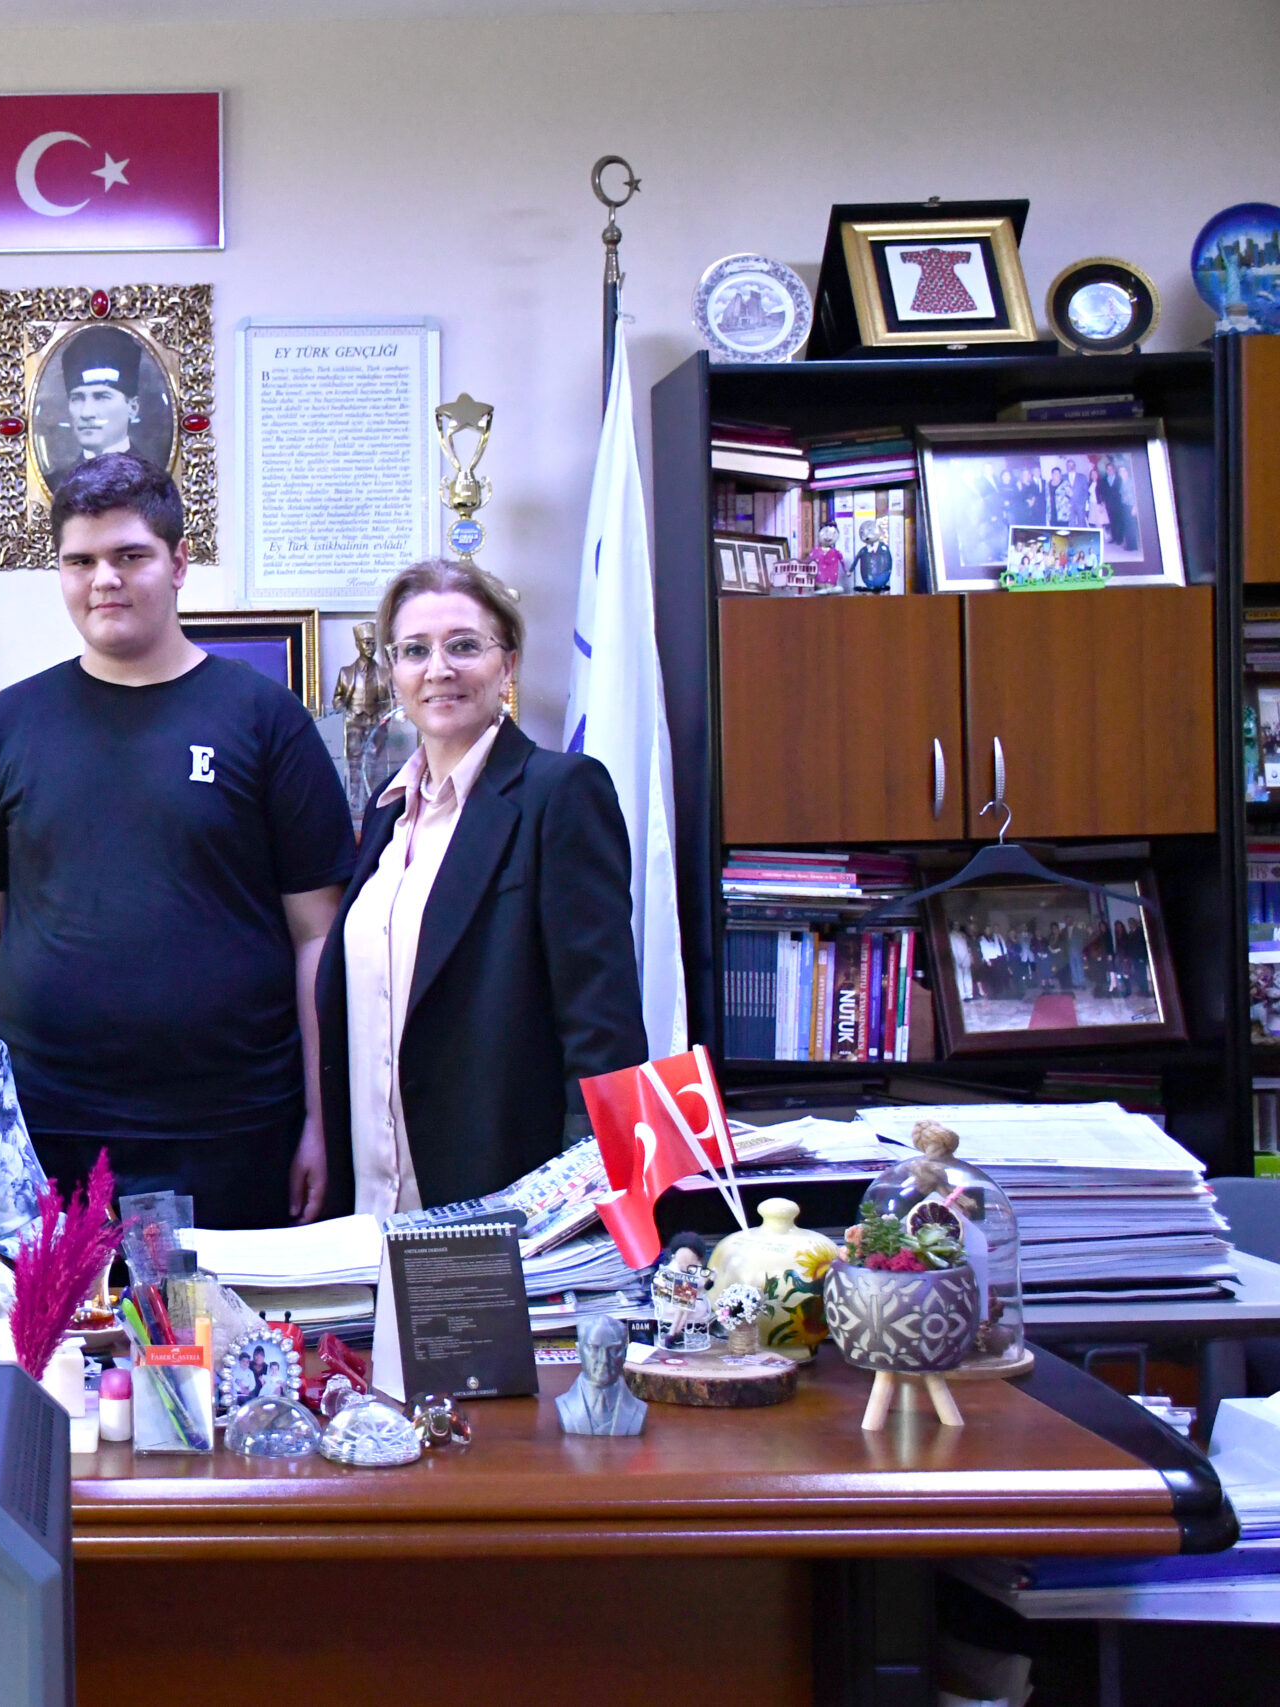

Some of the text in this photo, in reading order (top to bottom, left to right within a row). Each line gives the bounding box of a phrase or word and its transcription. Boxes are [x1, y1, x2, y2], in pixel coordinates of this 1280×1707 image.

[274, 343, 399, 360] EY TÜRK GENÇLİĞİ
[269, 542, 281, 553] Ey
[287, 540, 310, 551] Türk
[188, 744, 216, 784] E
[837, 989, 856, 1043] NUTUK
[631, 1322, 651, 1332] ADAM
